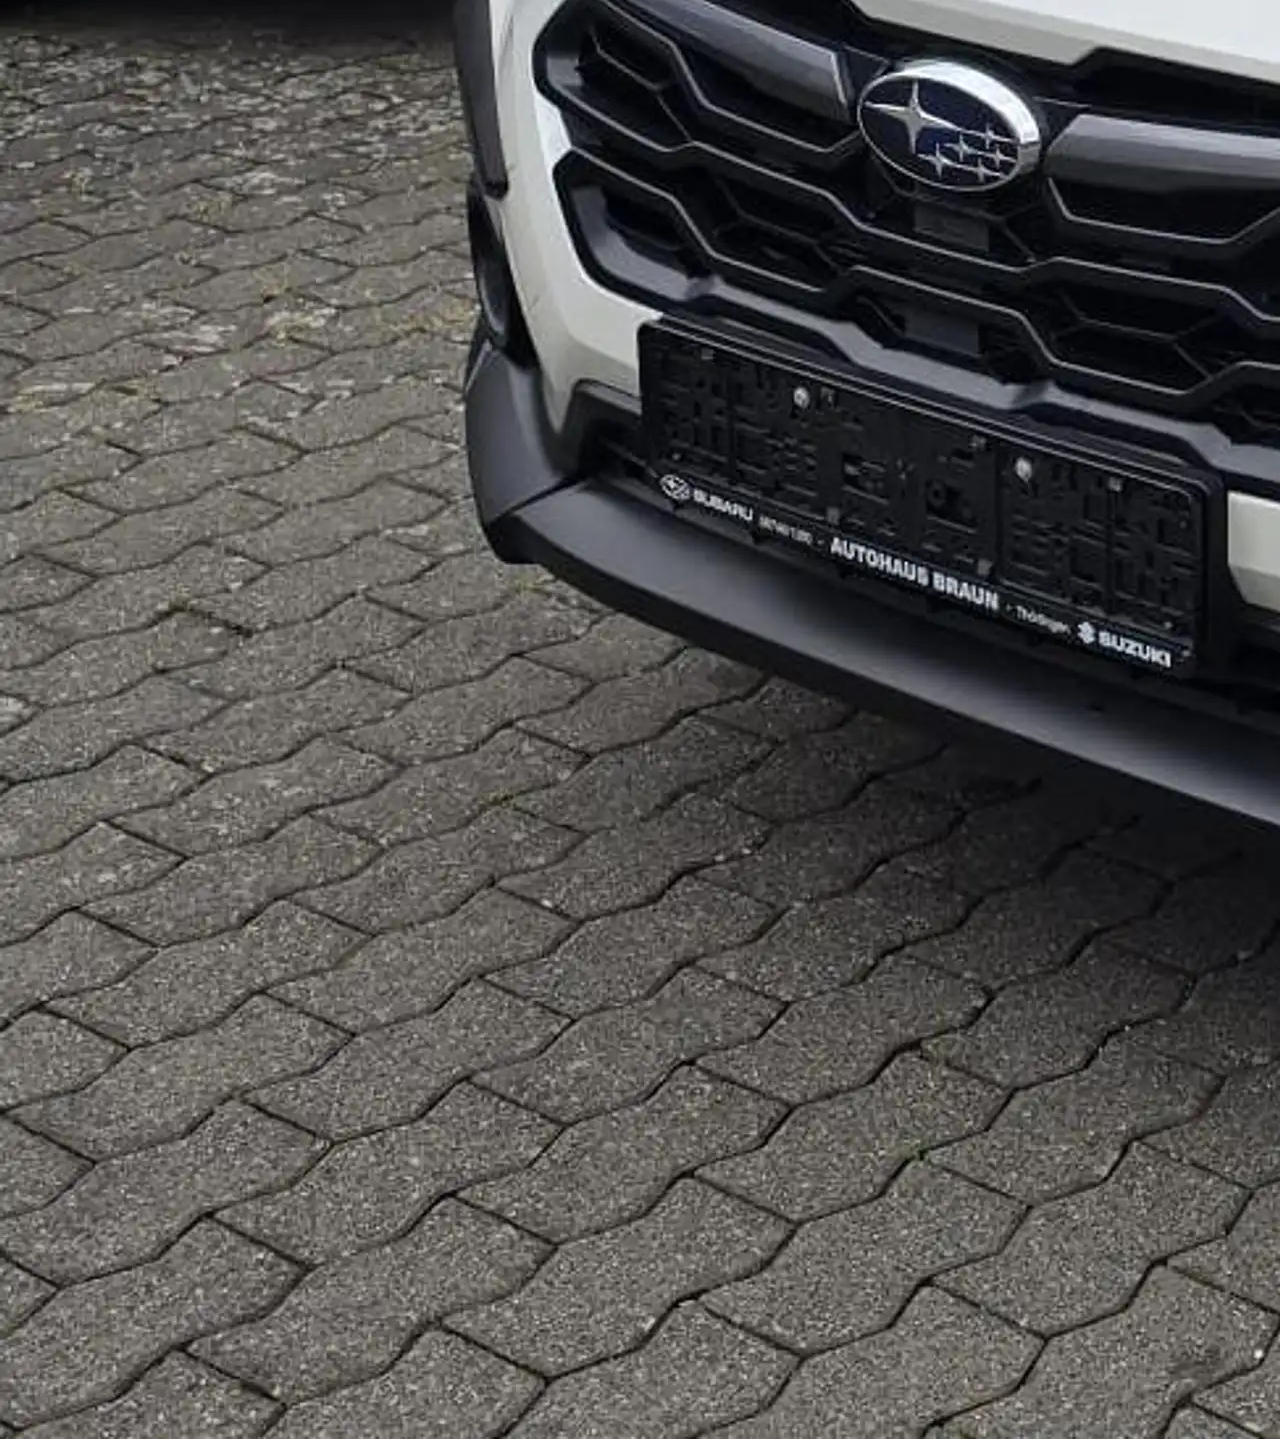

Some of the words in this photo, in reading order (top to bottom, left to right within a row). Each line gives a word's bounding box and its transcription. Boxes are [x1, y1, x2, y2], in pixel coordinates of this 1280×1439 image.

[693, 488, 754, 522] SUBARU
[830, 536, 930, 587] AUTOHAUS
[932, 571, 999, 611] BRAUN
[1098, 630, 1172, 668] SUZUKI
